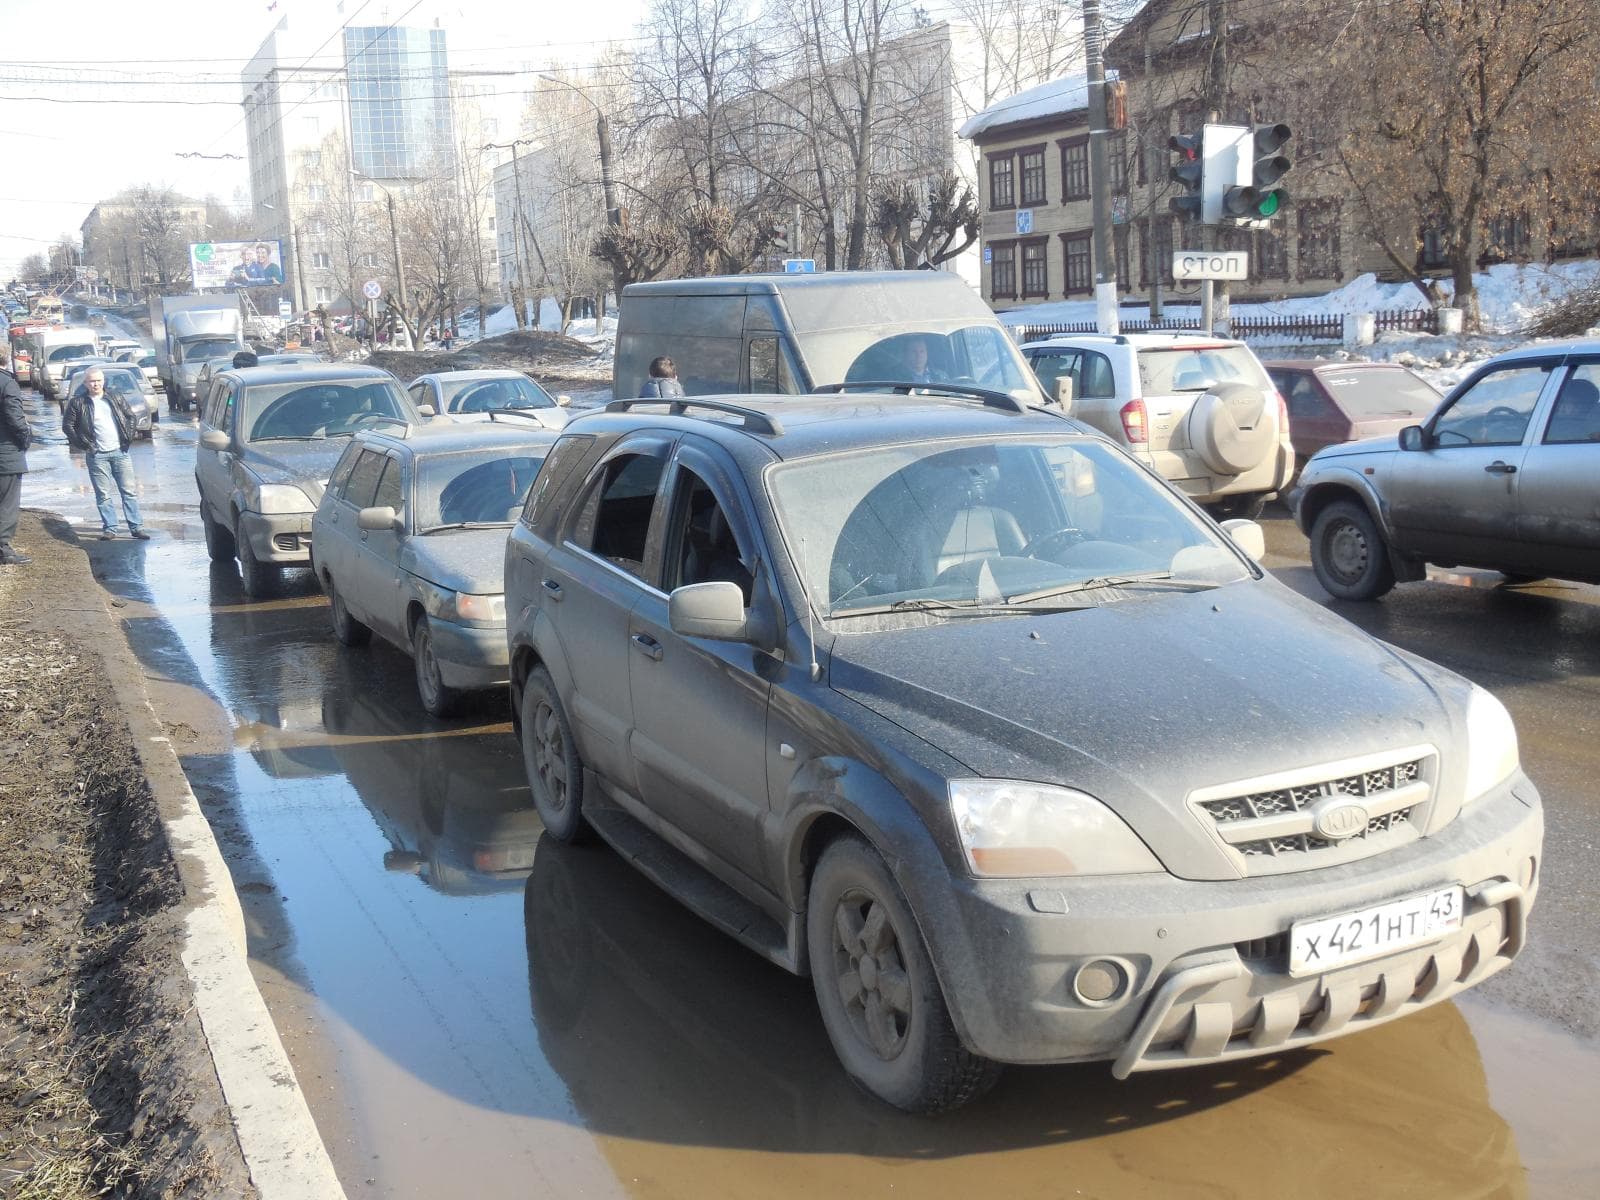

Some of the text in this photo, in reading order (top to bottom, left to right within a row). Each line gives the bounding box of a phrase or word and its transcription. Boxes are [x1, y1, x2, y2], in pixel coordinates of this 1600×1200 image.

[1183, 256, 1238, 274] СТОП
[1326, 808, 1361, 831] KIA
[1429, 892, 1454, 919] 43
